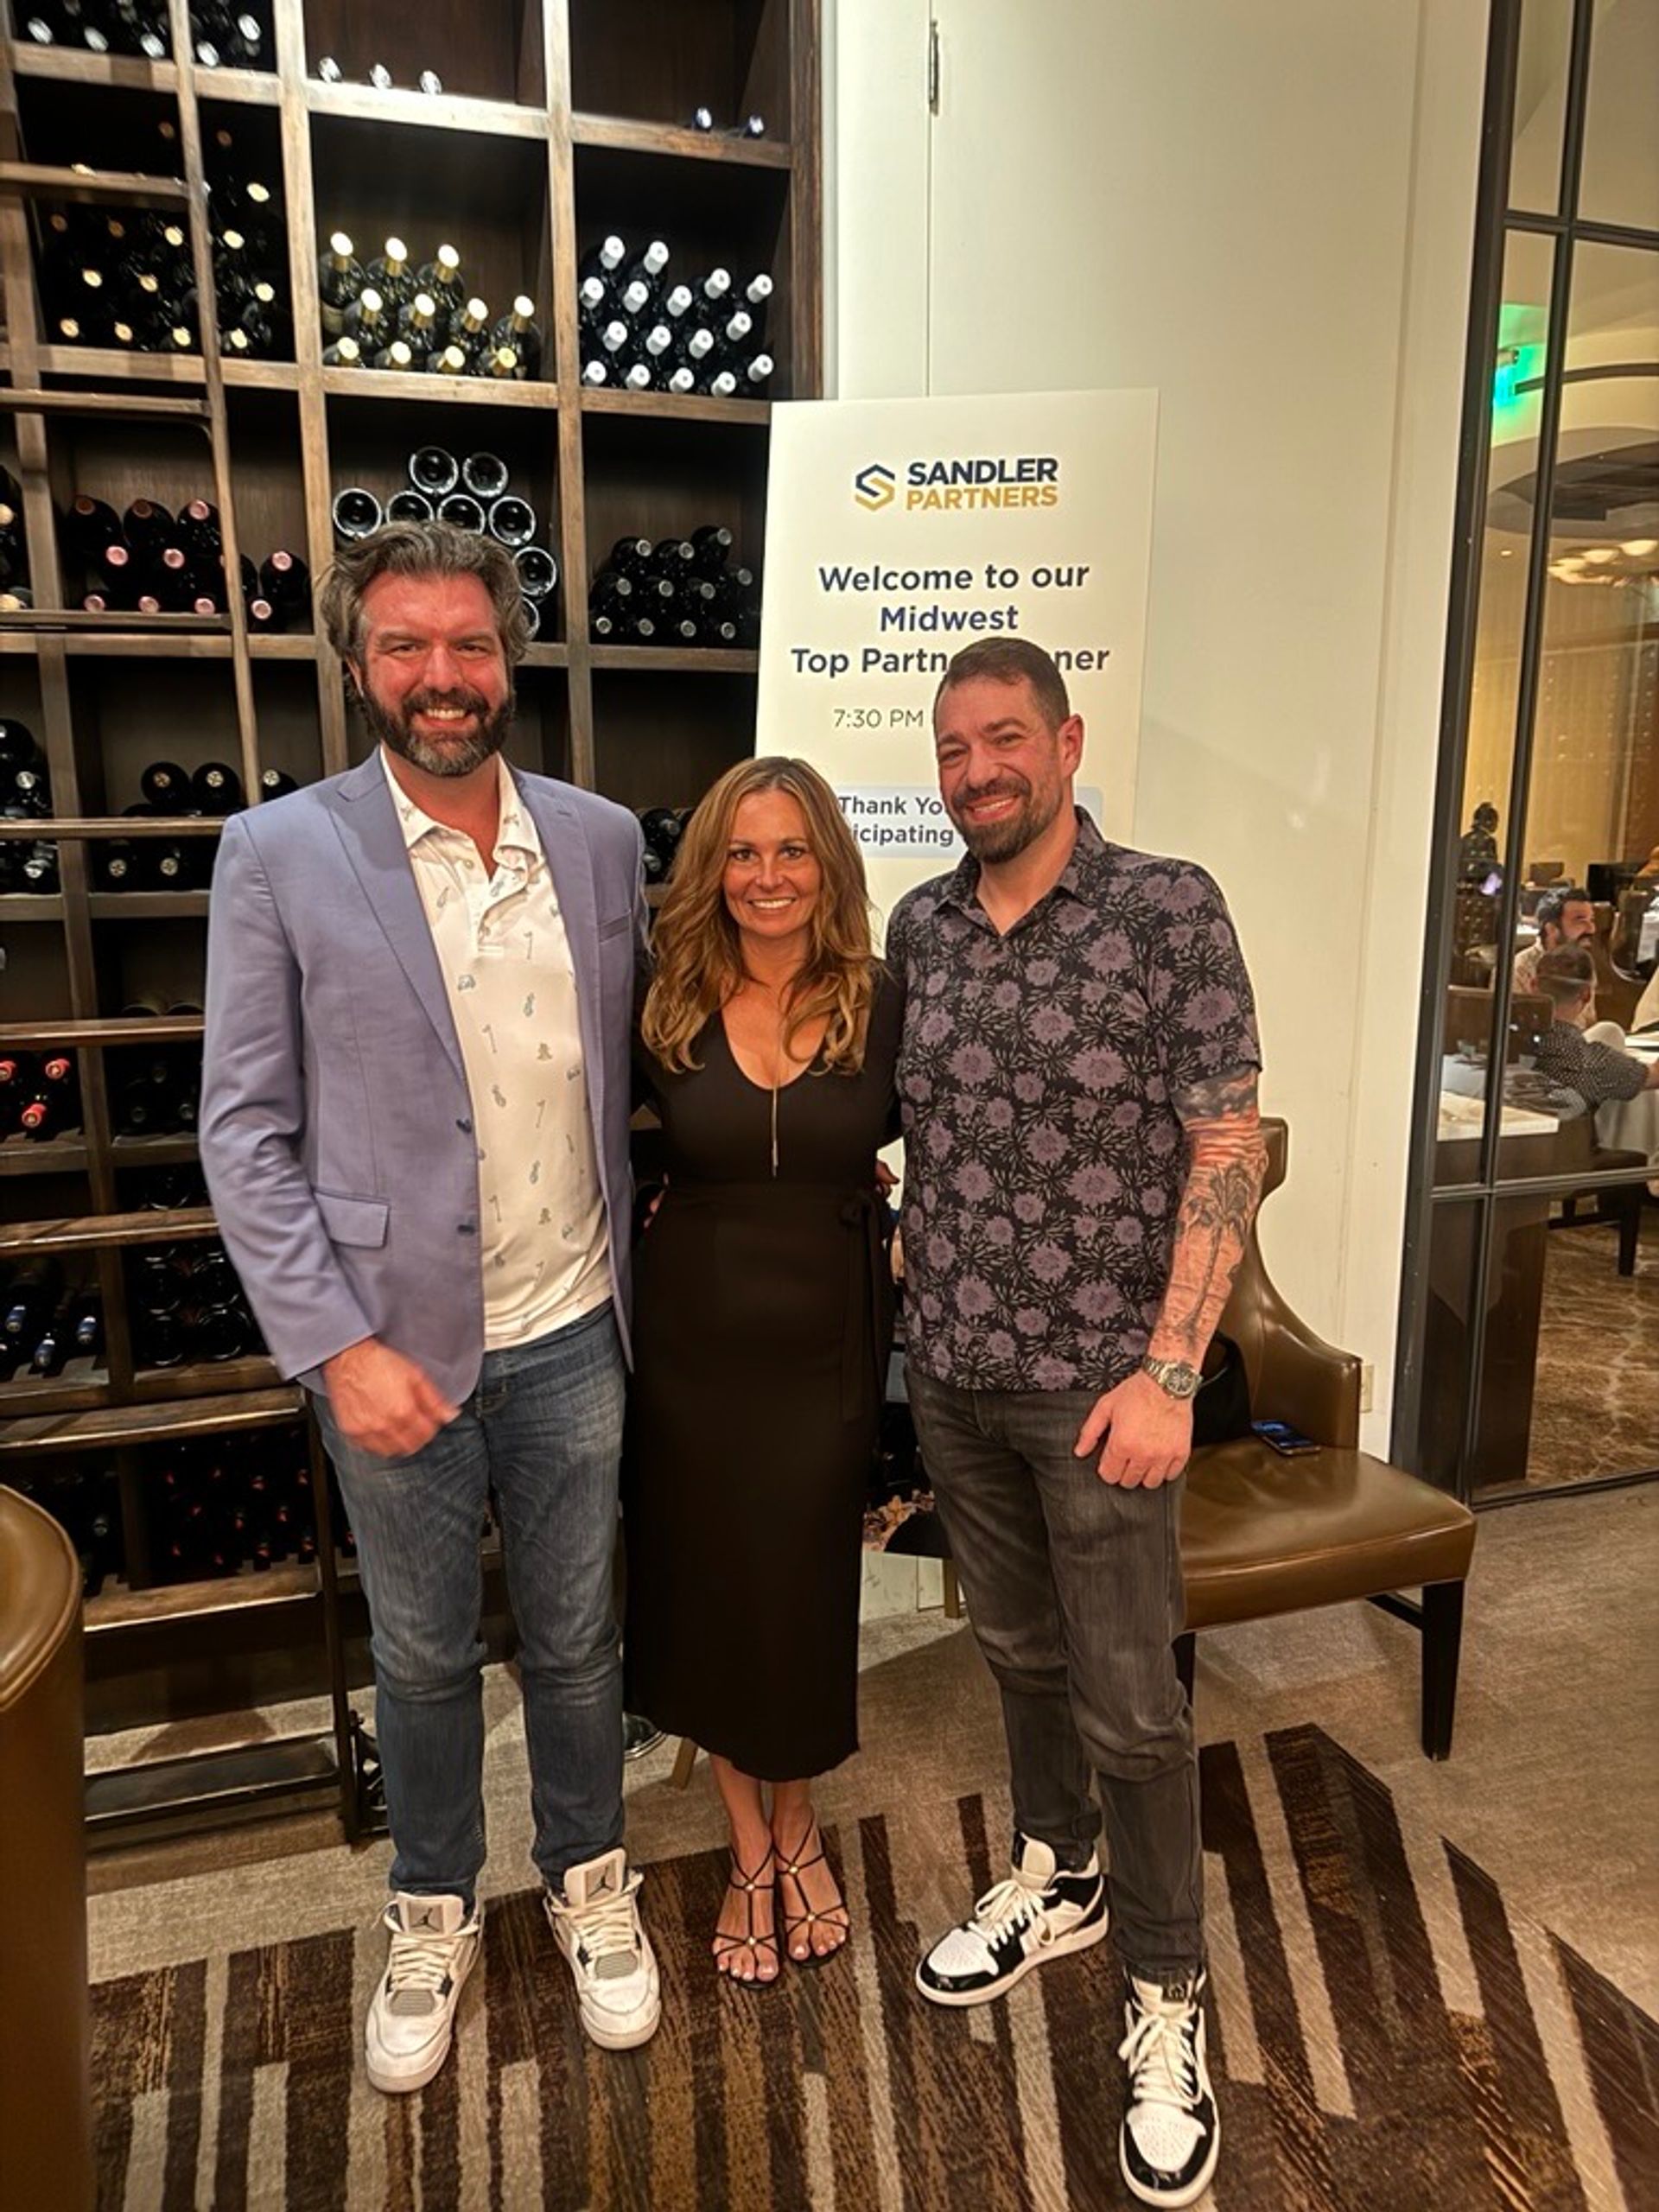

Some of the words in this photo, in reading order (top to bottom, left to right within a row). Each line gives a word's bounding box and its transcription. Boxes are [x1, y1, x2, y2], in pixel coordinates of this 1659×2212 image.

[906, 457, 1059, 486] SANDLER
[906, 486, 1058, 511] PARTNERS
[819, 565, 973, 592] Welcome
[985, 564, 1020, 589] to
[1032, 566, 1090, 588] our
[880, 605, 1020, 632] Midwest
[791, 648, 850, 678] Top
[862, 648, 948, 674] Partn
[1054, 649, 1110, 671] ner
[833, 709, 882, 729] 7:30
[889, 709, 925, 728] PM
[838, 796, 907, 816] Thank
[915, 797, 944, 816] Yo
[852, 823, 954, 848] icipating
